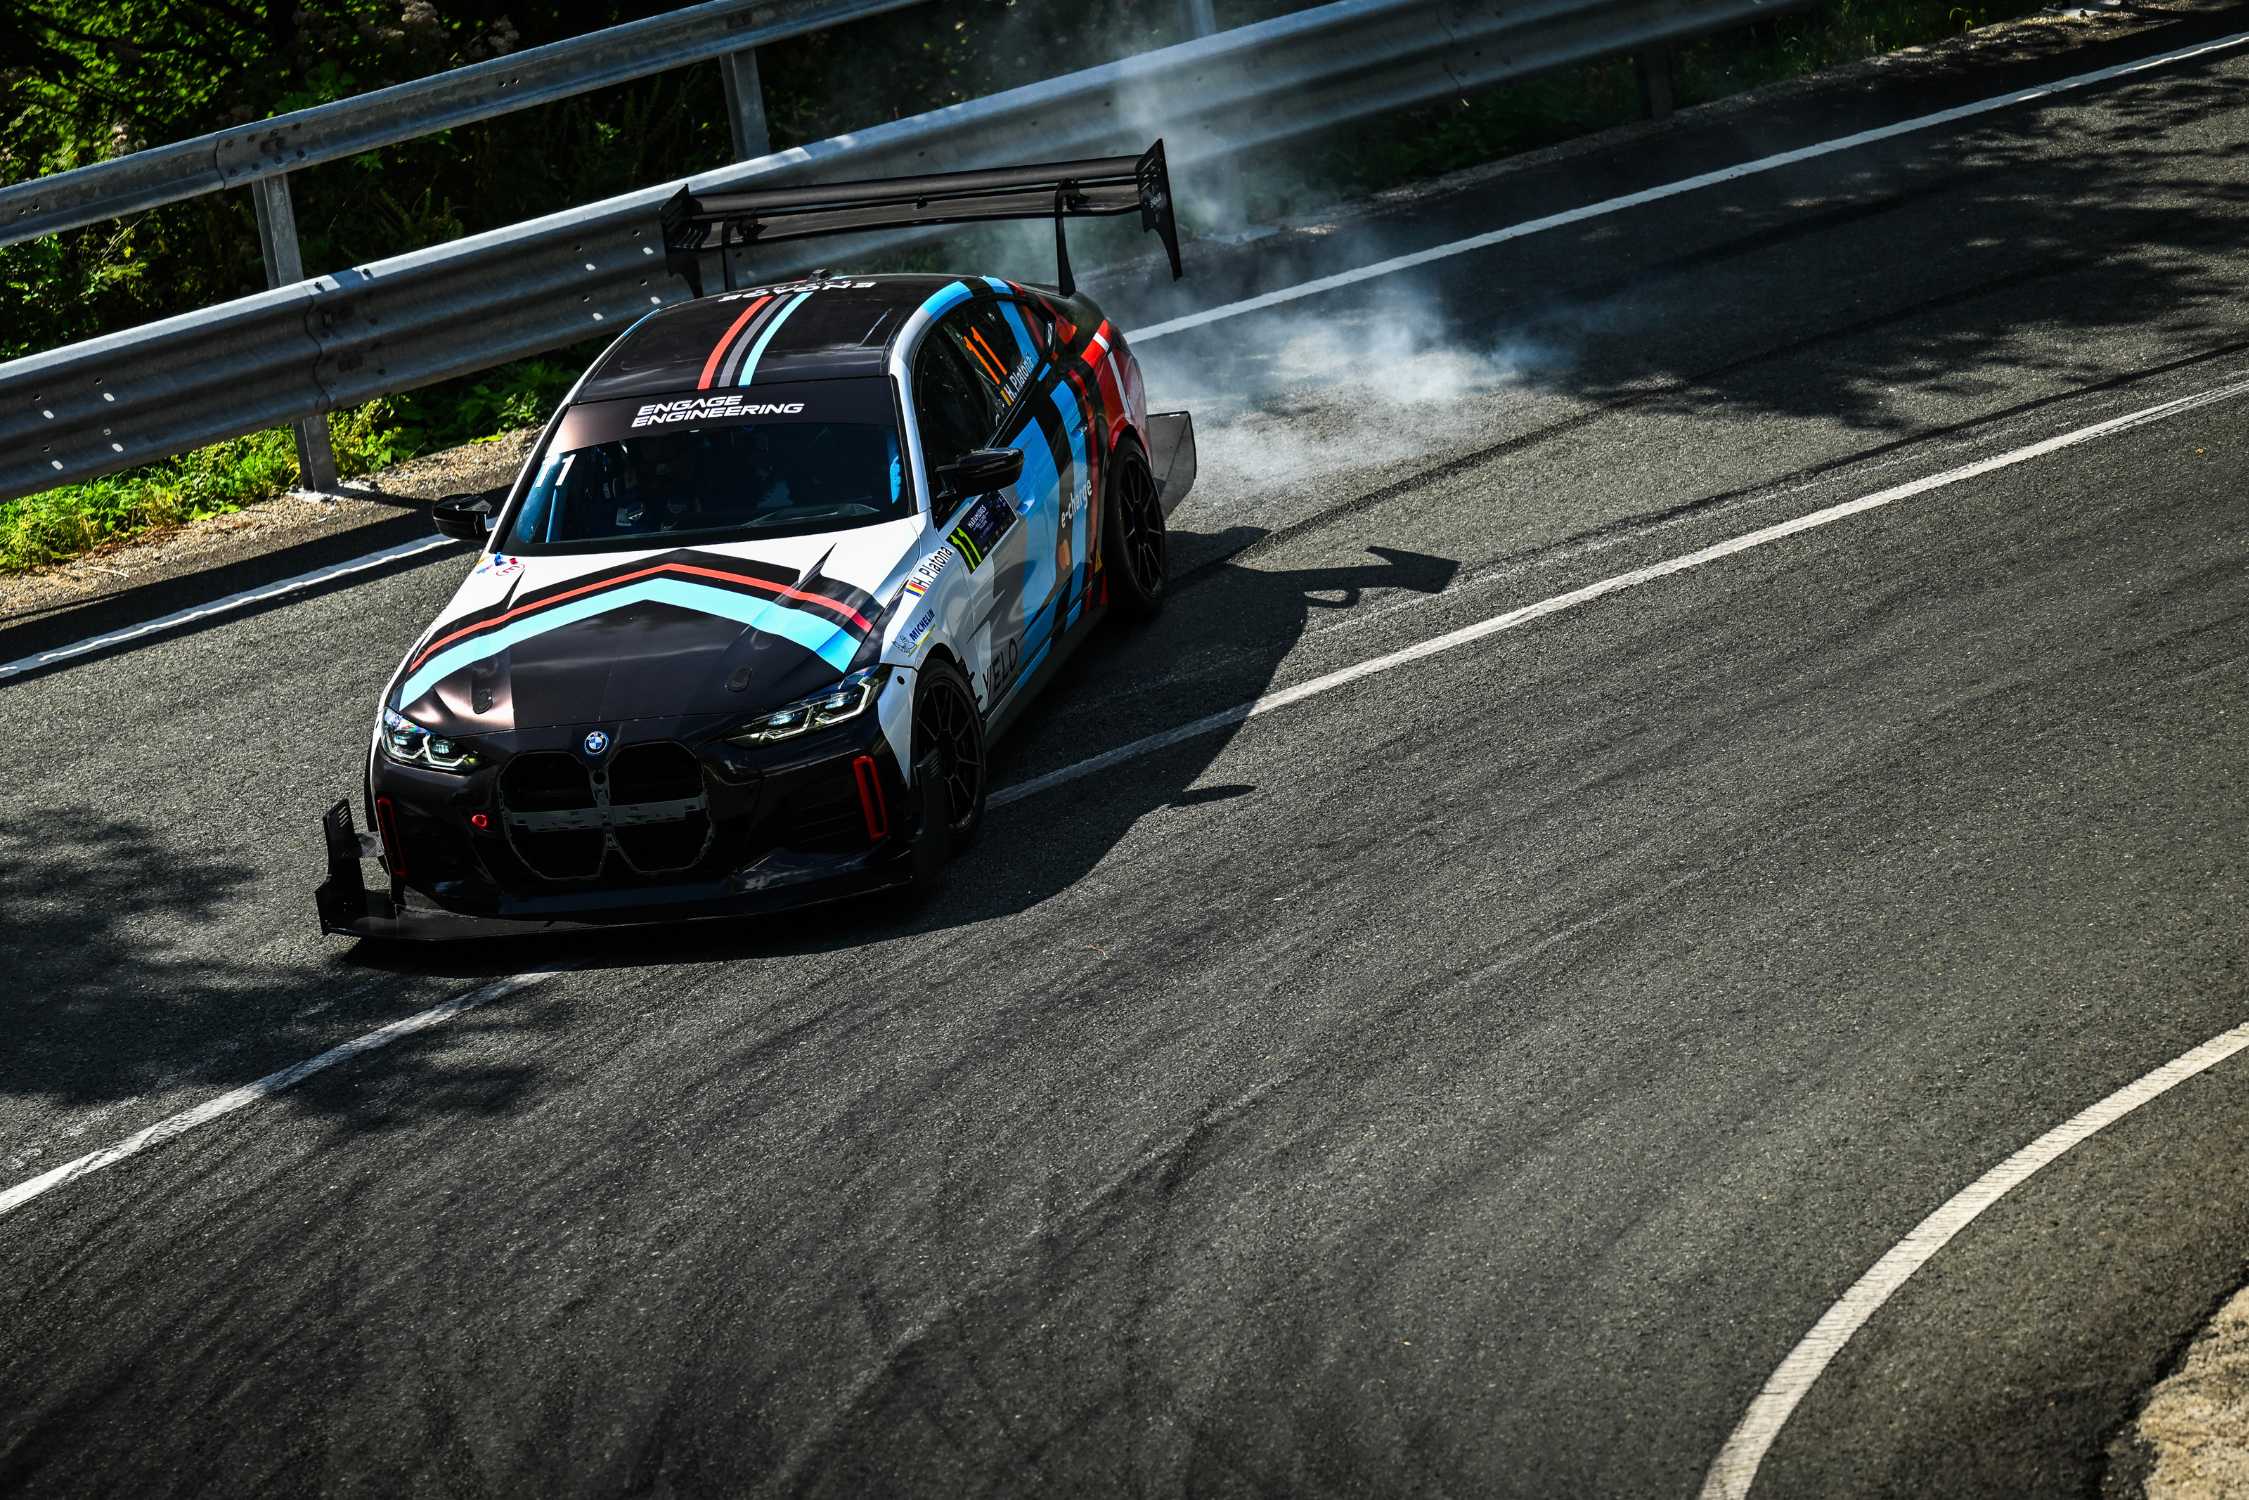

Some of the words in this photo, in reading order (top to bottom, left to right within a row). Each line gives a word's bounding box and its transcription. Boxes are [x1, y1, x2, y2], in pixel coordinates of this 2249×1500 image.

[963, 324, 1008, 385] 11
[631, 402, 805, 428] ENGINEERING
[637, 394, 744, 416] ENGAGE
[1061, 479, 1093, 529] e-charge
[918, 546, 953, 581] Platona
[950, 526, 983, 570] 11
[909, 607, 936, 641] MICHELIN
[983, 638, 1018, 701] VELO
